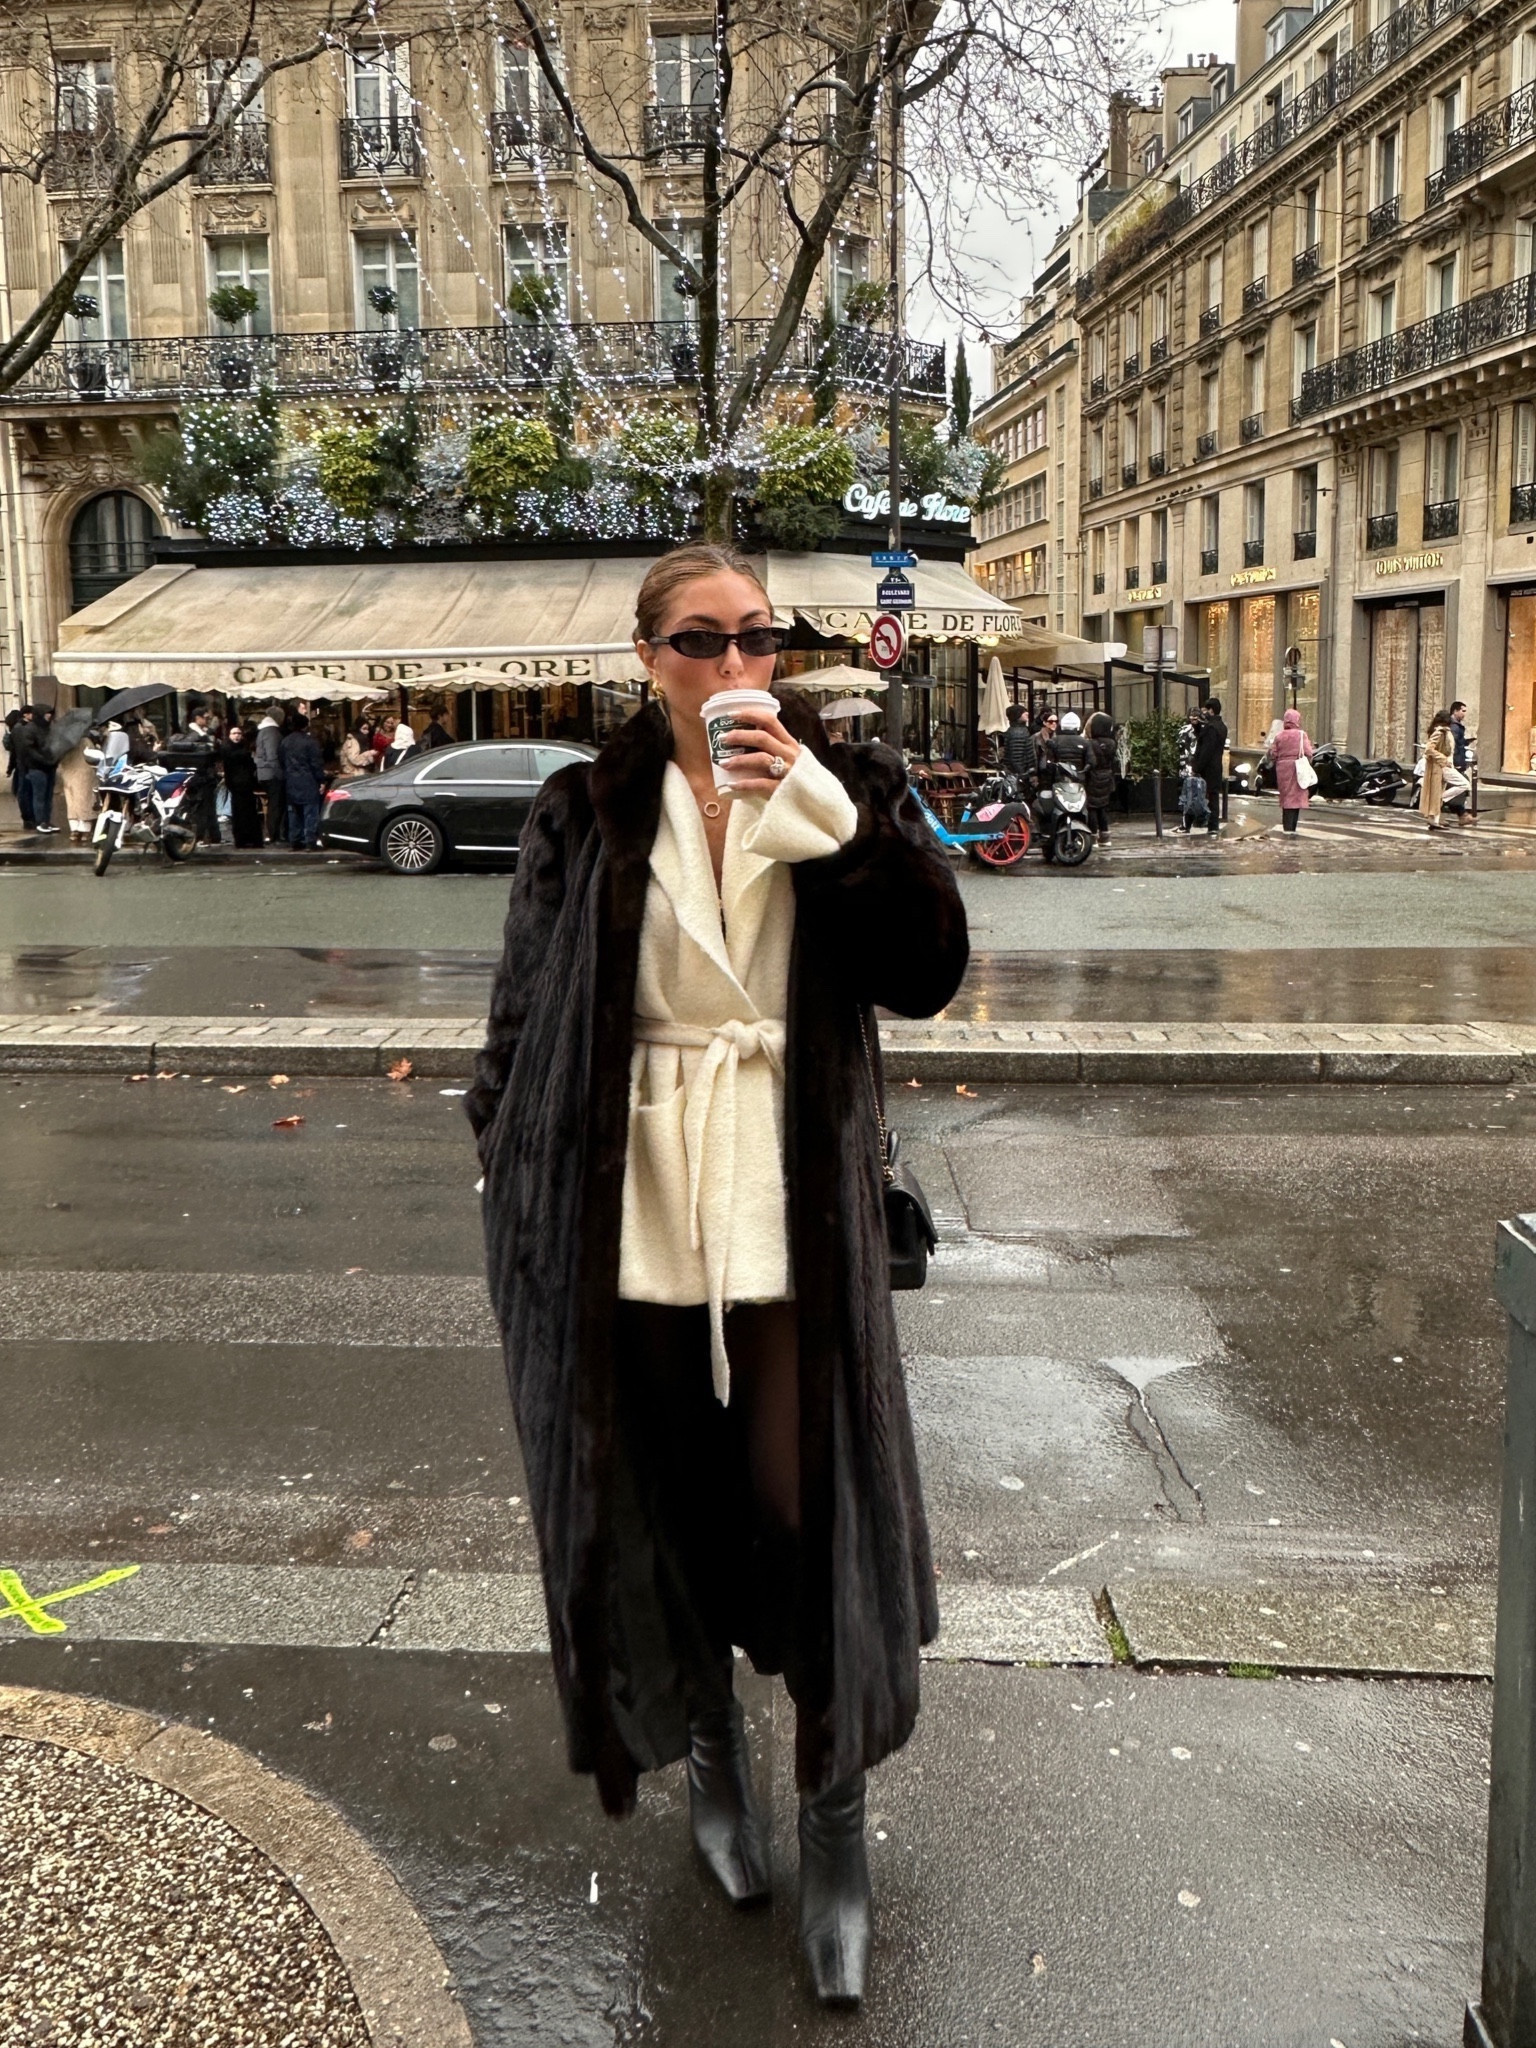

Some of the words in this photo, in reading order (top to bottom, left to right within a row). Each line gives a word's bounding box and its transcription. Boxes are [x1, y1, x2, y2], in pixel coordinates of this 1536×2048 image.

[920, 491, 971, 523] Flore
[825, 612, 928, 630] CAE
[942, 614, 974, 632] DE
[366, 663, 423, 682] DE
